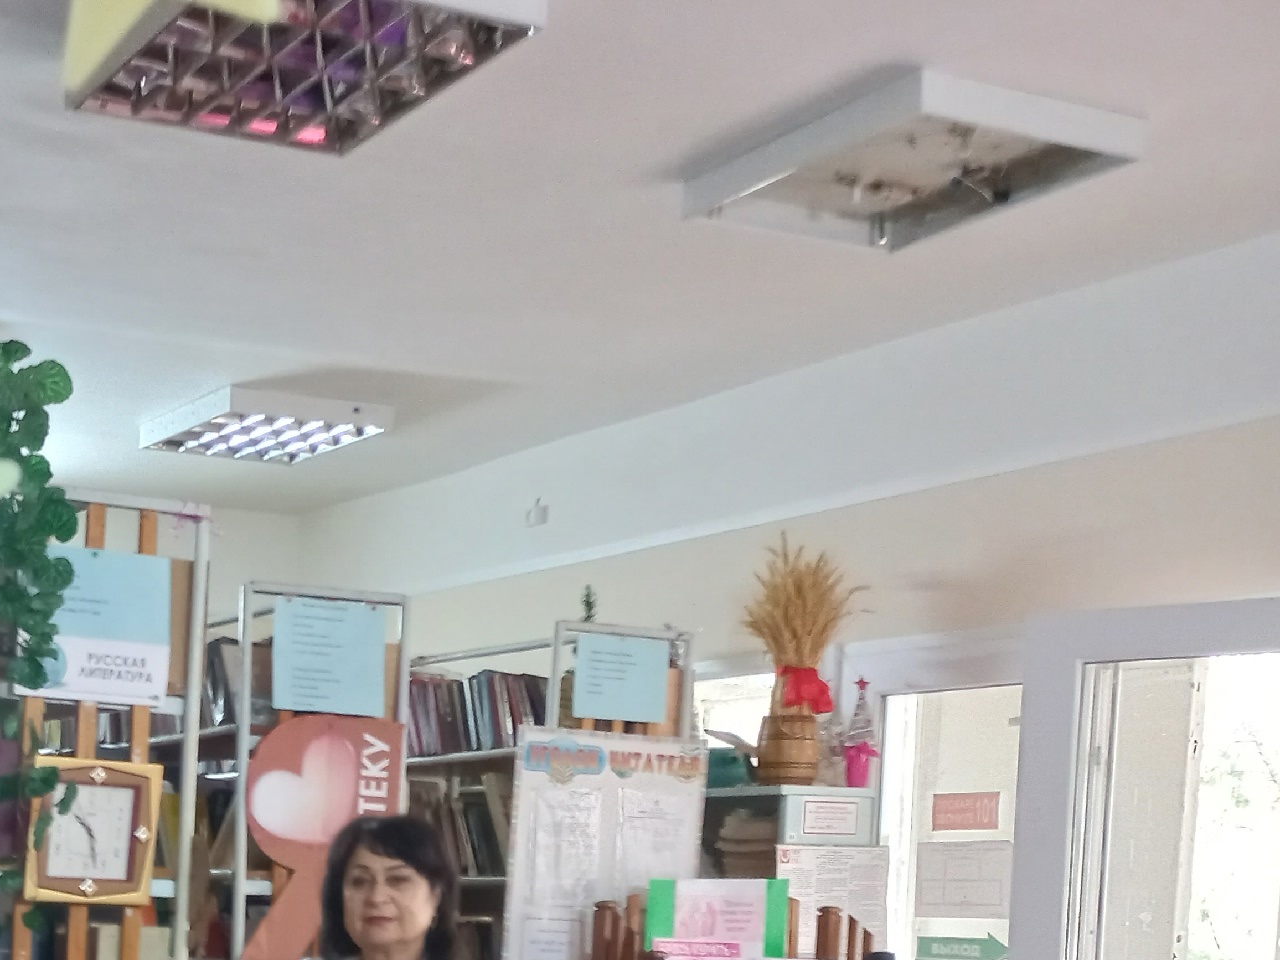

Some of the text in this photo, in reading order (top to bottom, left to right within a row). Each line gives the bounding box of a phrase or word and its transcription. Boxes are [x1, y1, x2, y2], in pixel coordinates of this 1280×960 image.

[86, 652, 148, 669] РУССКАЯ
[78, 667, 154, 684] ЛИТЕРАТУРА
[357, 732, 391, 815] ТЕКУ
[931, 943, 981, 958] ВЫХОД
